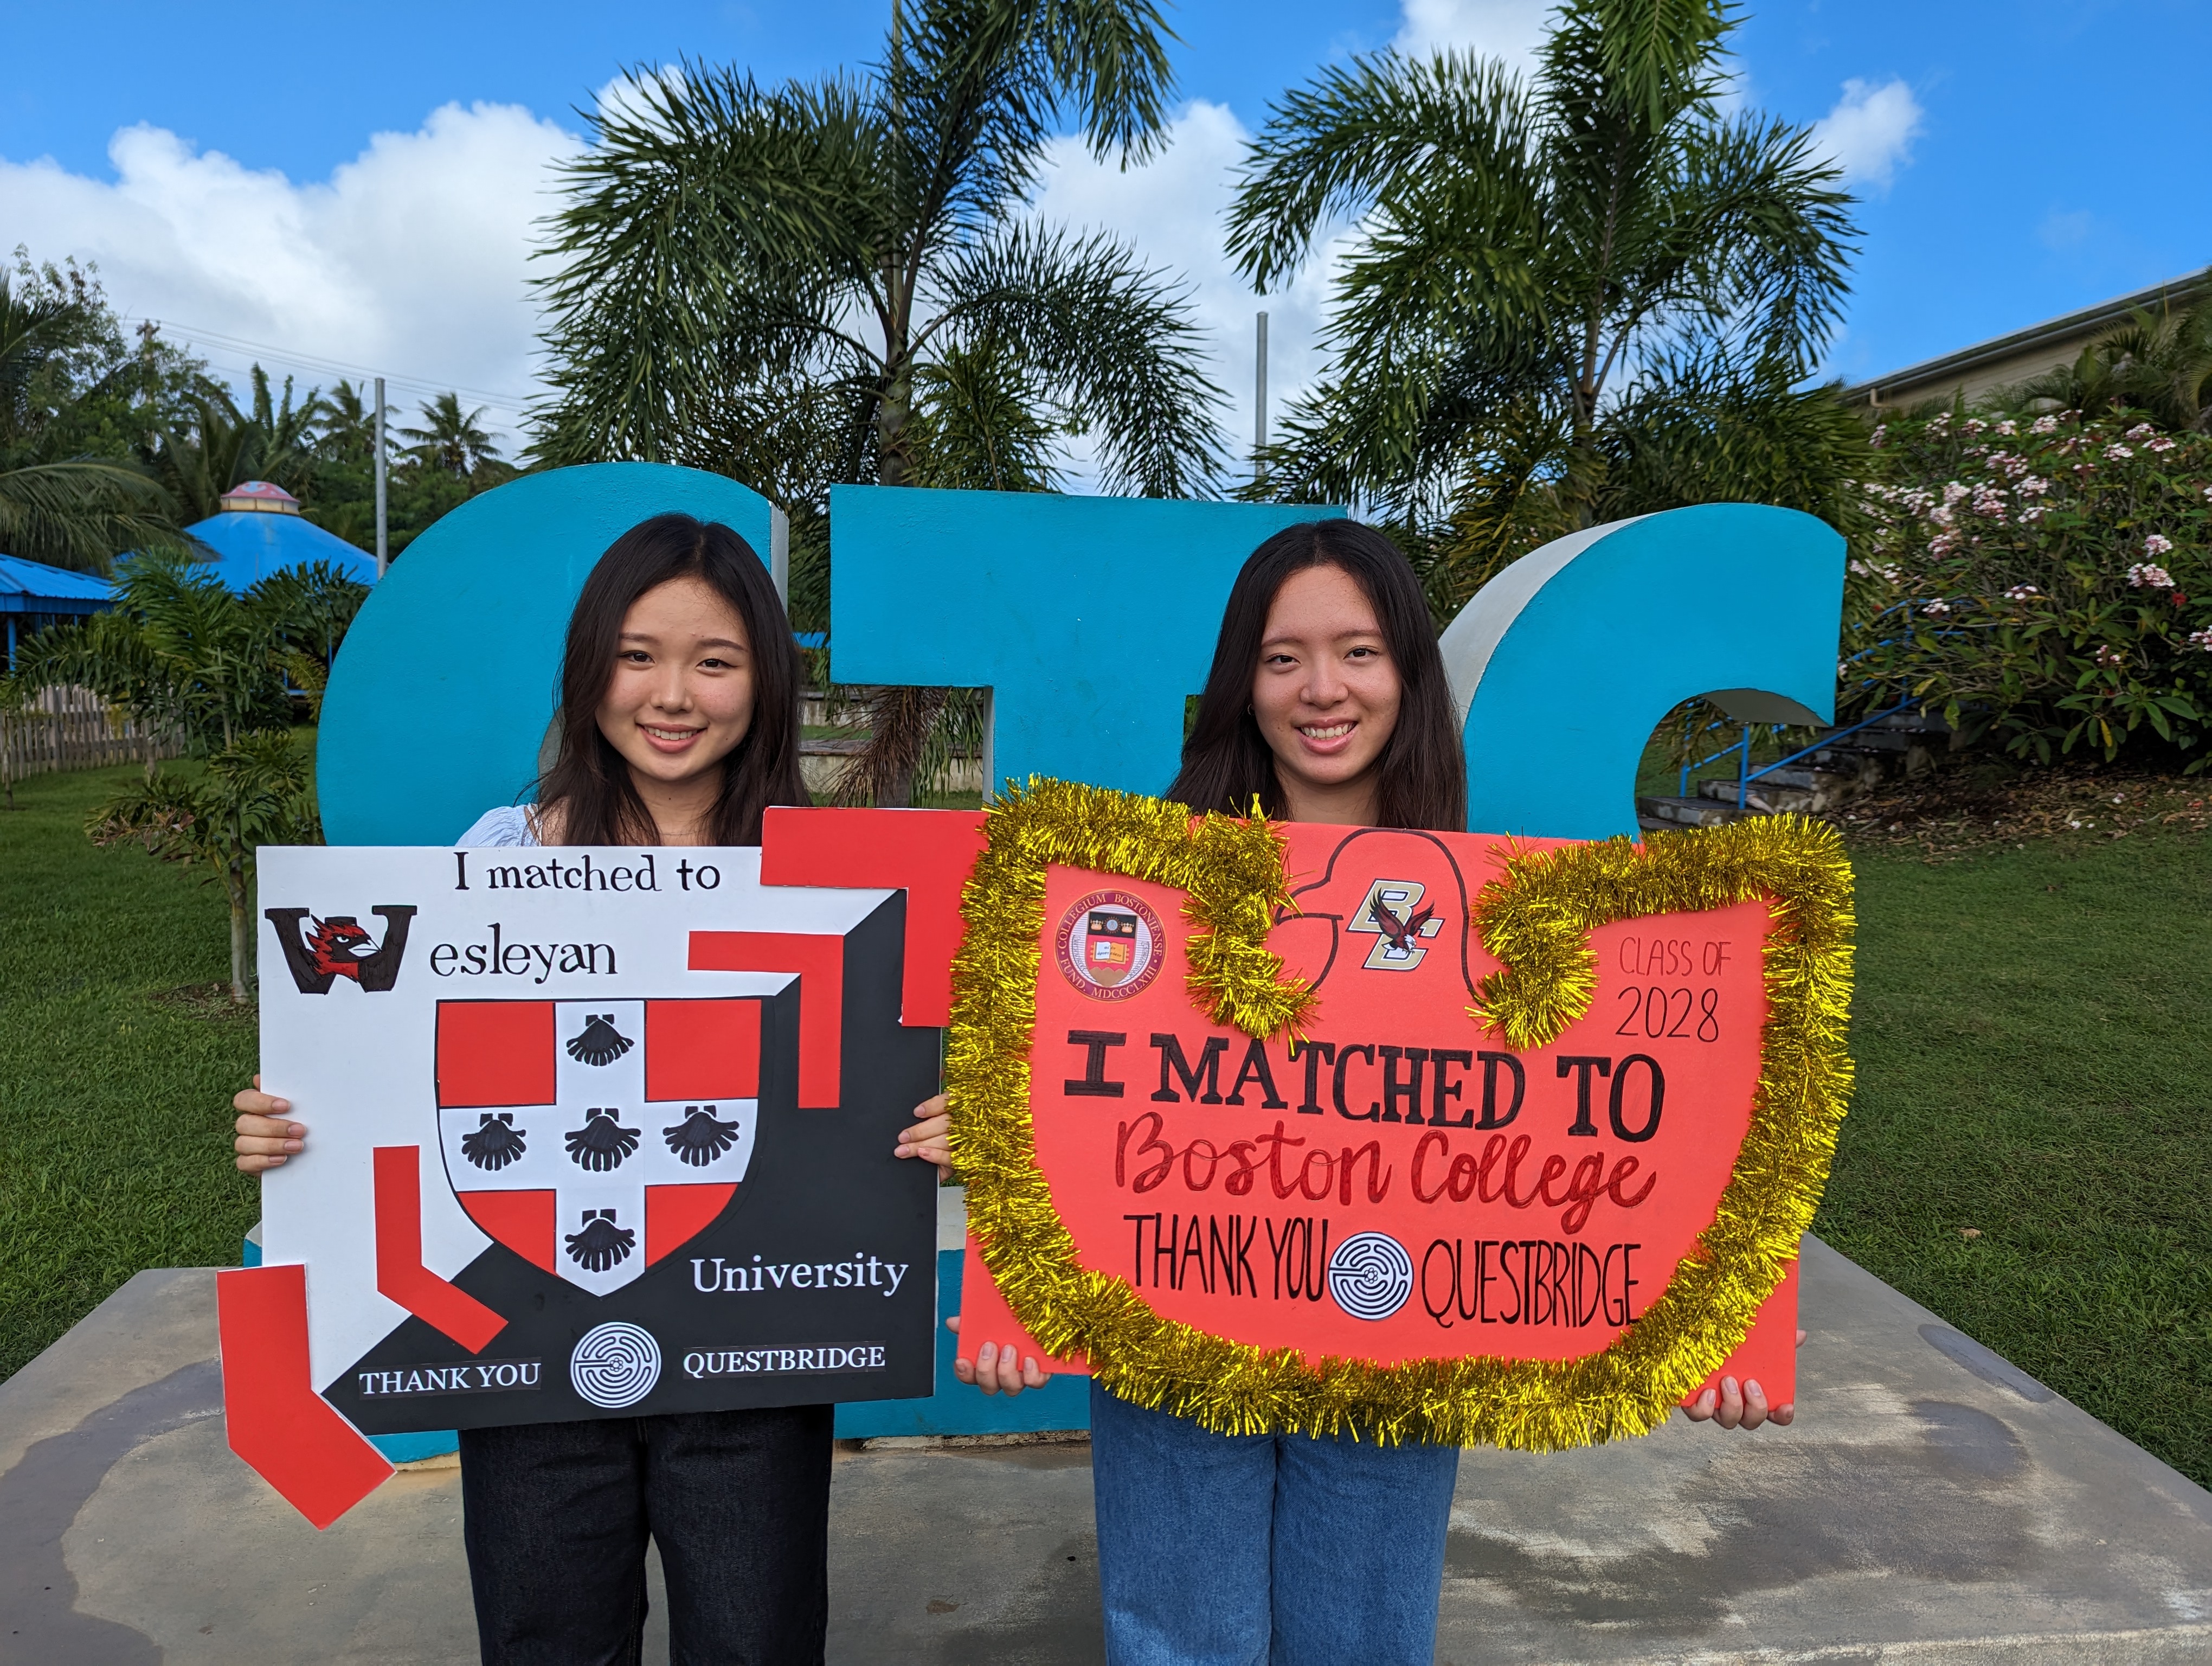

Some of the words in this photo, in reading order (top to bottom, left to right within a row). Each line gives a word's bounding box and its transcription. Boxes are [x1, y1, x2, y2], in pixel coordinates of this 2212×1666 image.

[453, 851, 470, 890] I
[486, 854, 663, 892] matched
[676, 858, 721, 891] to
[1058, 894, 1107, 950] COLLEGIUM
[1114, 894, 1163, 957] BOSTONIENSE
[1060, 958, 1086, 992] FUND.
[1091, 966, 1157, 999] MDCCCLXIII
[1619, 937, 1694, 977] CLASS
[1702, 941, 1732, 977] OF
[1615, 986, 1719, 1043] 2028
[1064, 1030, 1127, 1098] I
[1150, 1033, 1525, 1130] MATCHED
[1556, 1053, 1666, 1143] TO
[1115, 1112, 1391, 1206] Boston
[1411, 1130, 1658, 1235] College
[690, 1252, 909, 1297] University
[1123, 1213, 1258, 1299] THANK
[1265, 1217, 1329, 1302] YOU
[1421, 1238, 1642, 1328] QUESTBRIDGE
[360, 1368, 472, 1395] THANK
[477, 1362, 542, 1388] YOU
[683, 1346, 886, 1379] QUESTBRIDGE
